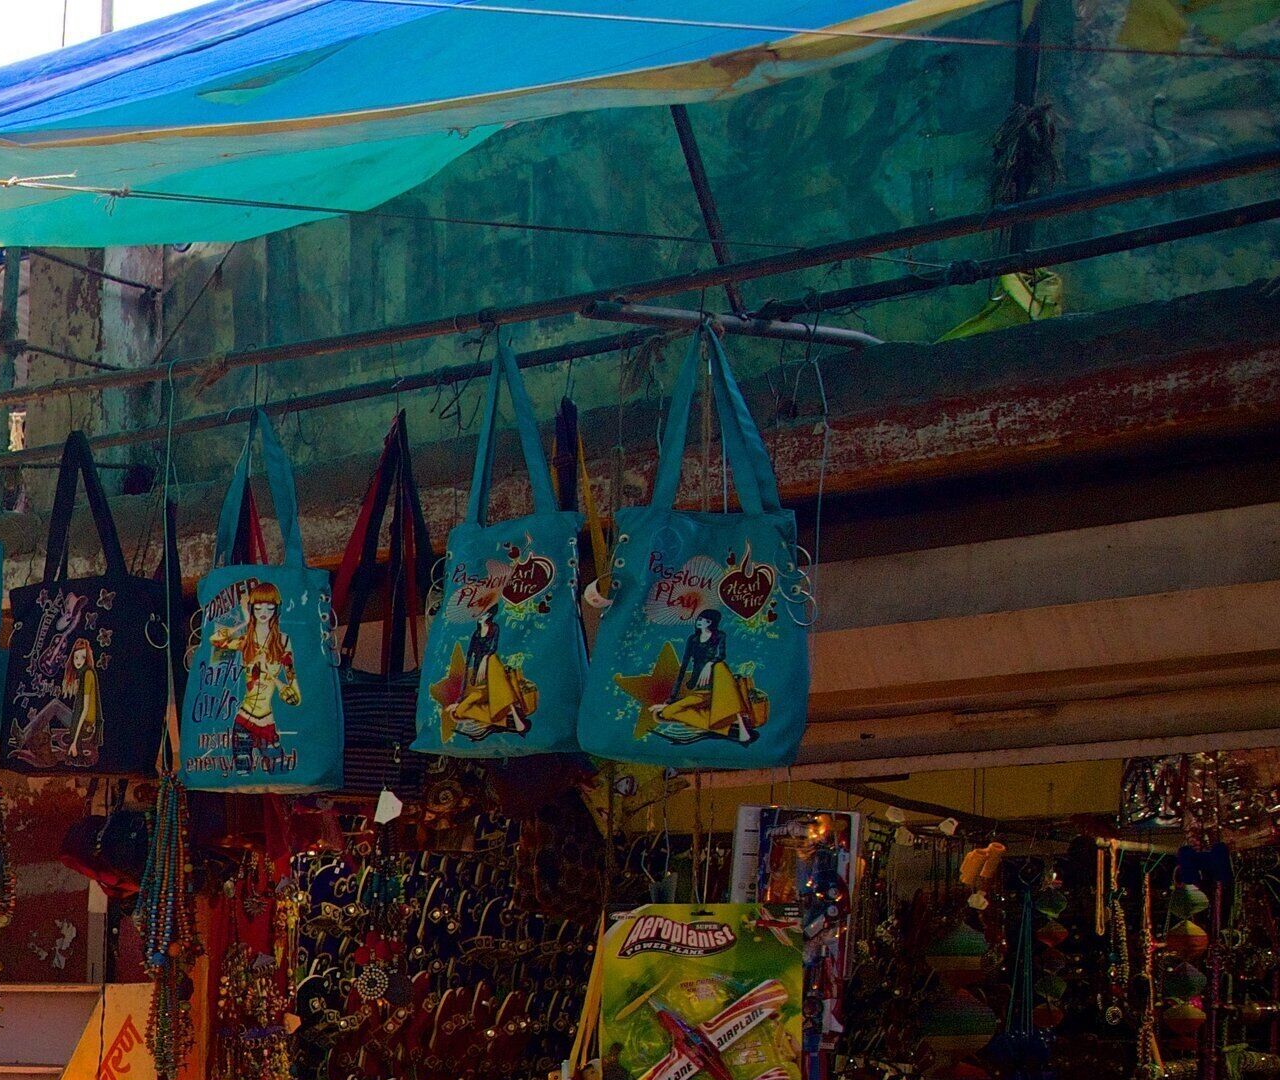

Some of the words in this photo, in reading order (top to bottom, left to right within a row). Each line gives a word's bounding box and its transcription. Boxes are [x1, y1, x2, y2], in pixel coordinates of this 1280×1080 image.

[648, 551, 712, 589] Passion
[655, 581, 698, 620] Play
[626, 914, 736, 949] Aeroplanist
[694, 922, 719, 930] SUPER
[625, 942, 667, 956] POWER
[669, 943, 705, 956] PLANE
[716, 1006, 765, 1048] AIRPLANE
